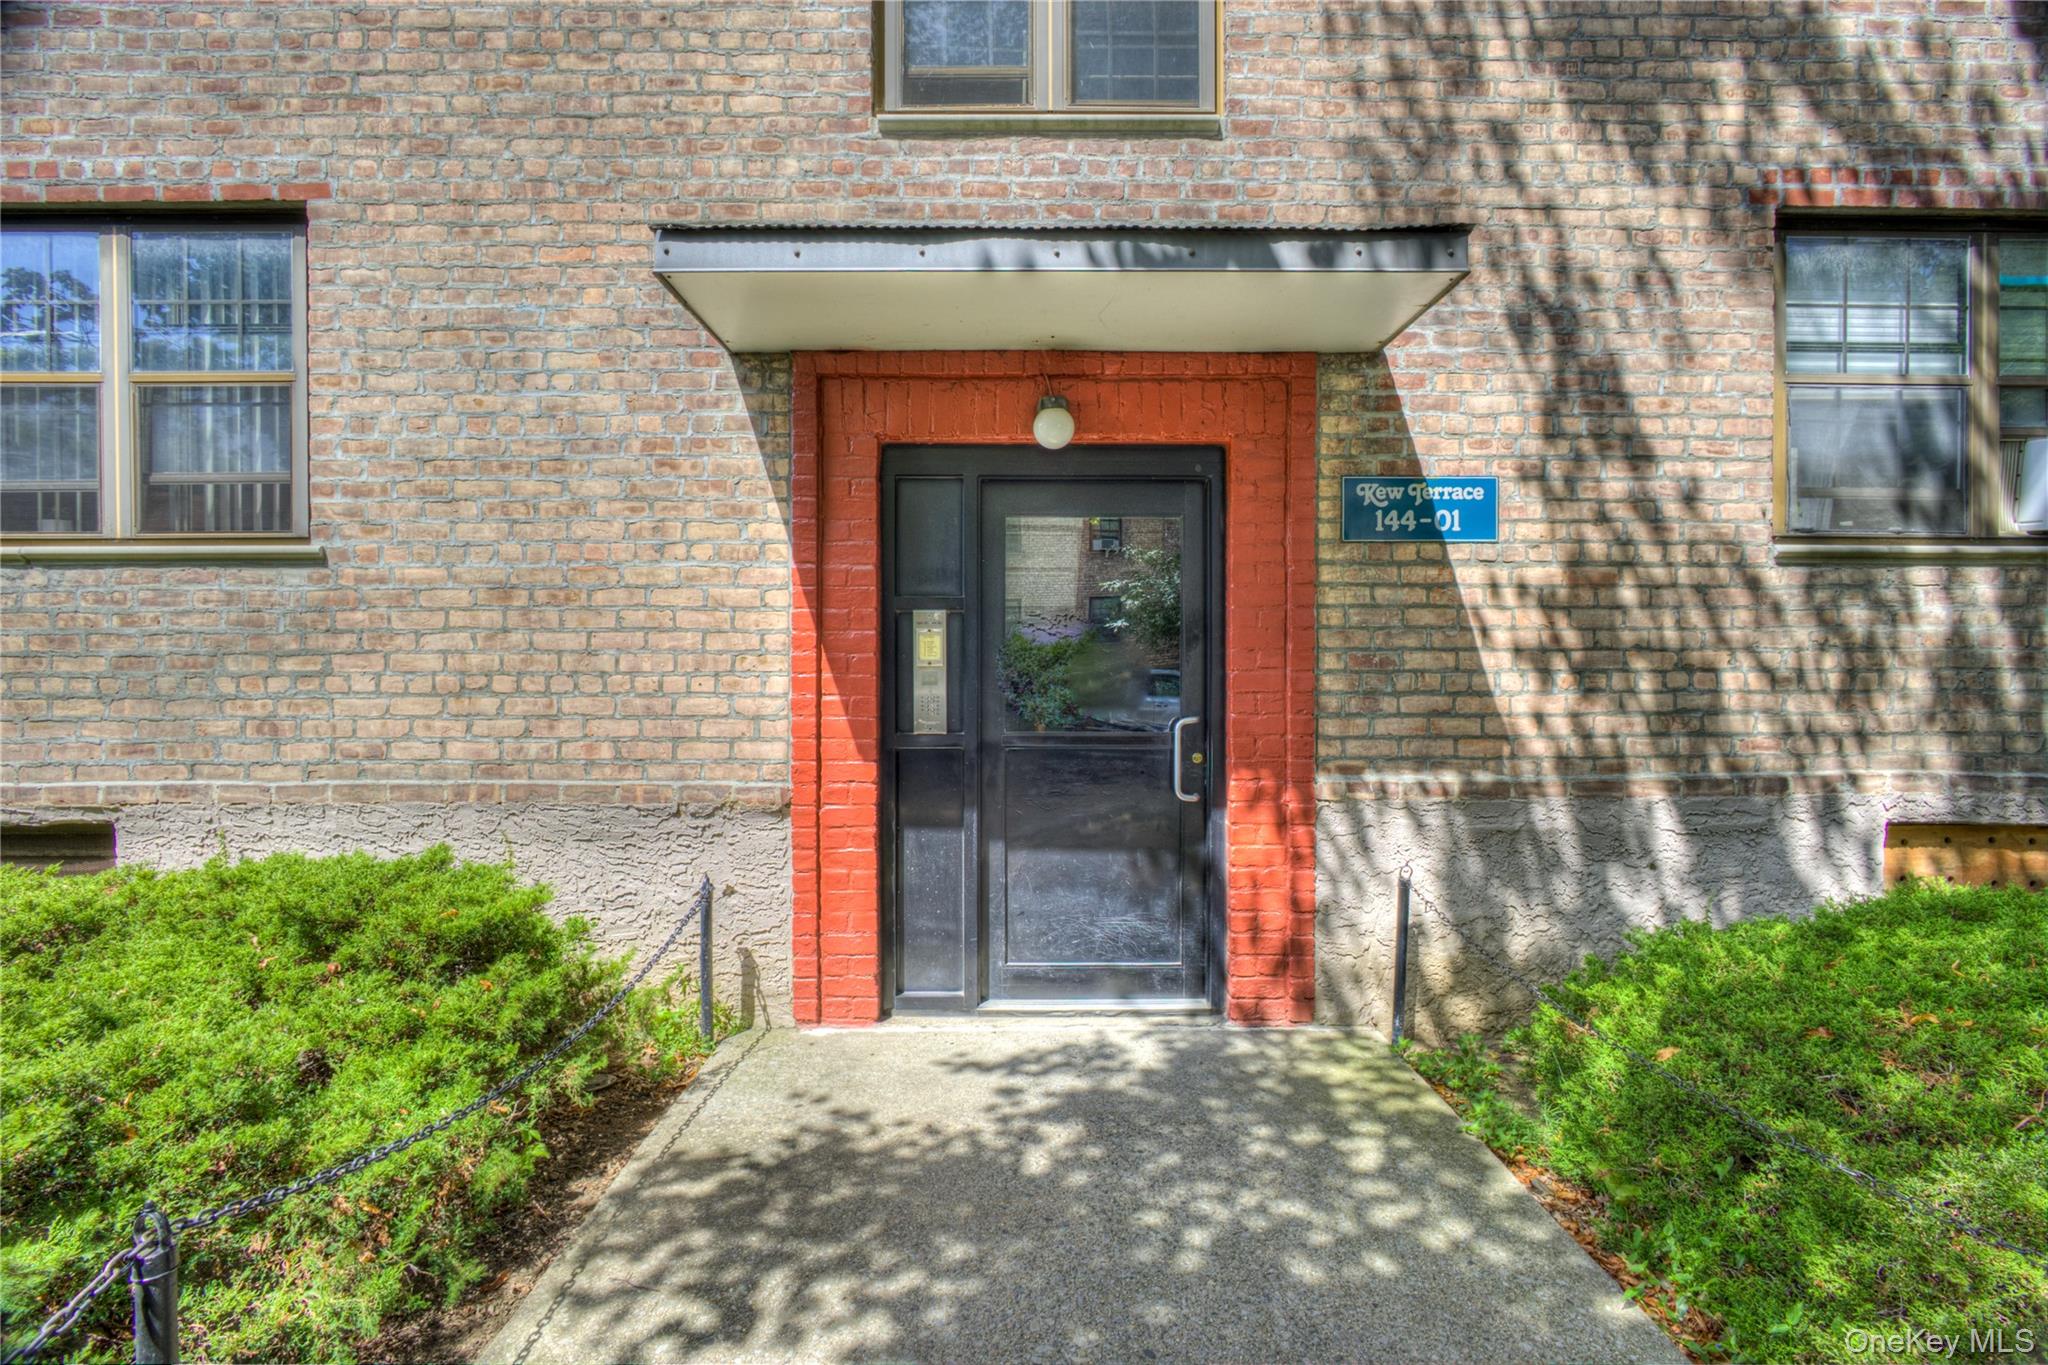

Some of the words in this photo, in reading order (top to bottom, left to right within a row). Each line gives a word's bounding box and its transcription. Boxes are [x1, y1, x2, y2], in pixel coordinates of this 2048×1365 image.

[1356, 483, 1404, 507] Kew
[1407, 482, 1485, 506] Terrace
[1375, 509, 1461, 531] 144-01
